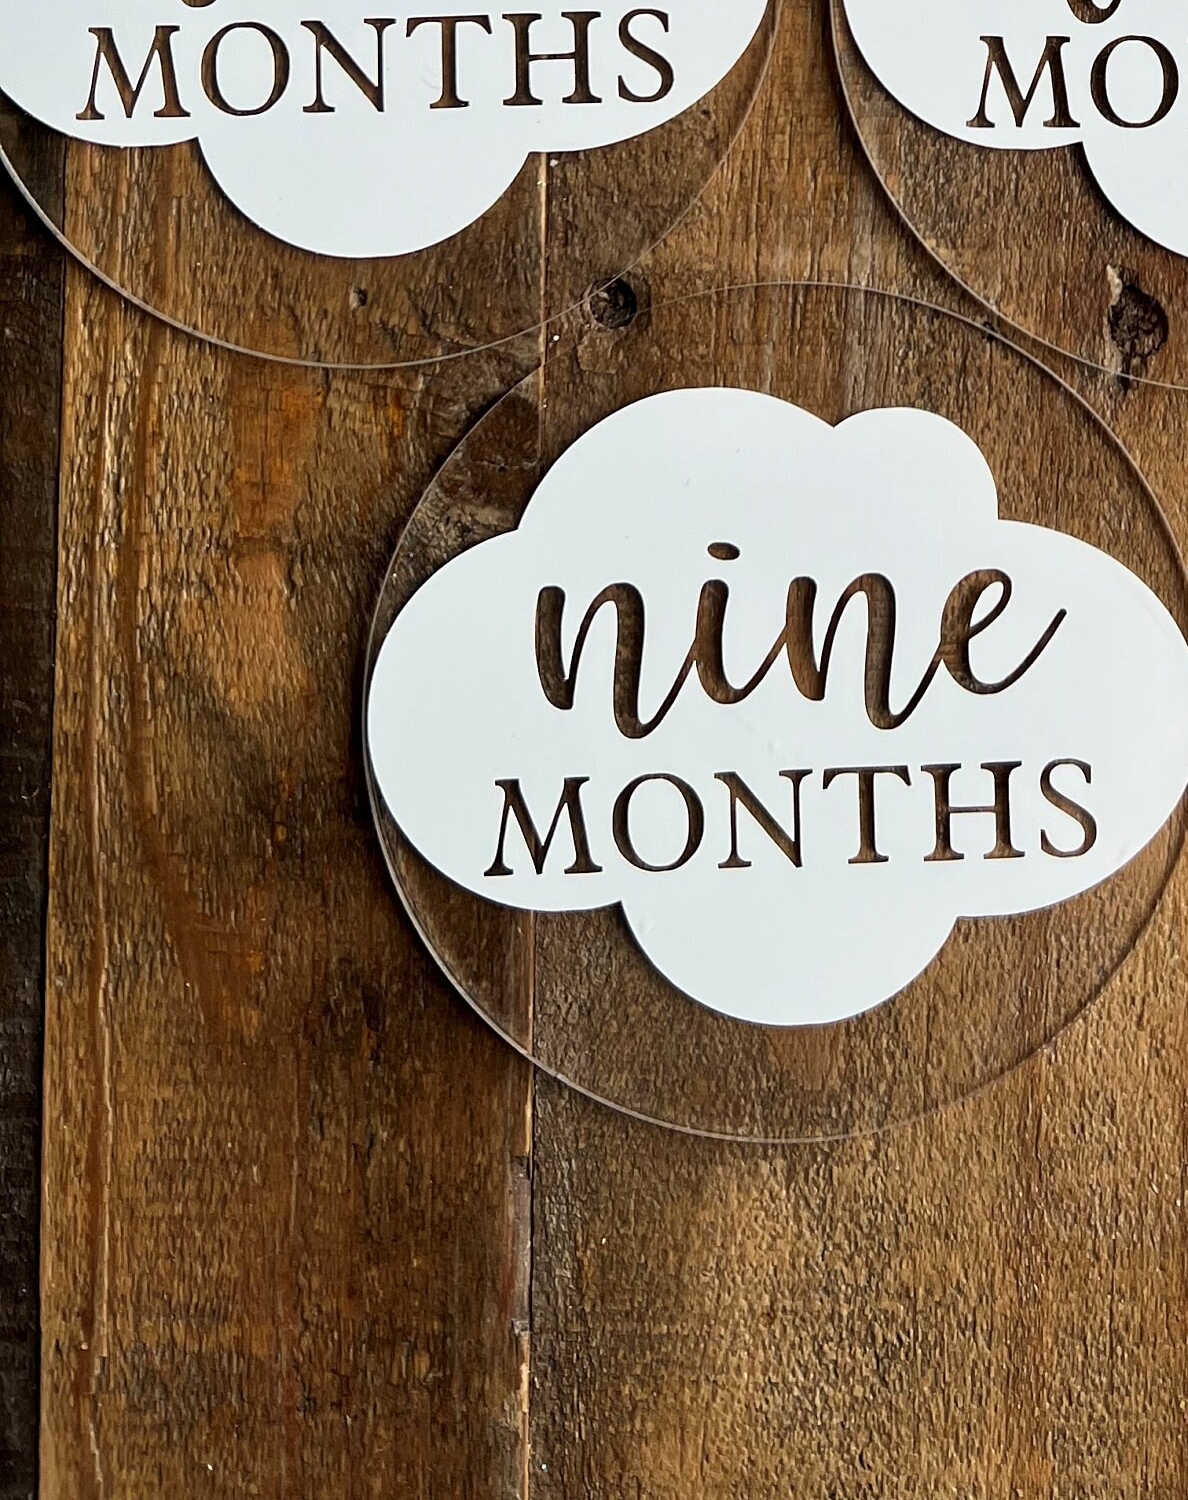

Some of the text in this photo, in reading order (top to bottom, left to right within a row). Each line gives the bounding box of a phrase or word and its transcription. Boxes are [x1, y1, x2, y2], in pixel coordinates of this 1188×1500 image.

[76, 9, 674, 120] MONTHS
[535, 543, 1067, 739] nine
[484, 759, 1097, 876] MONTHS
